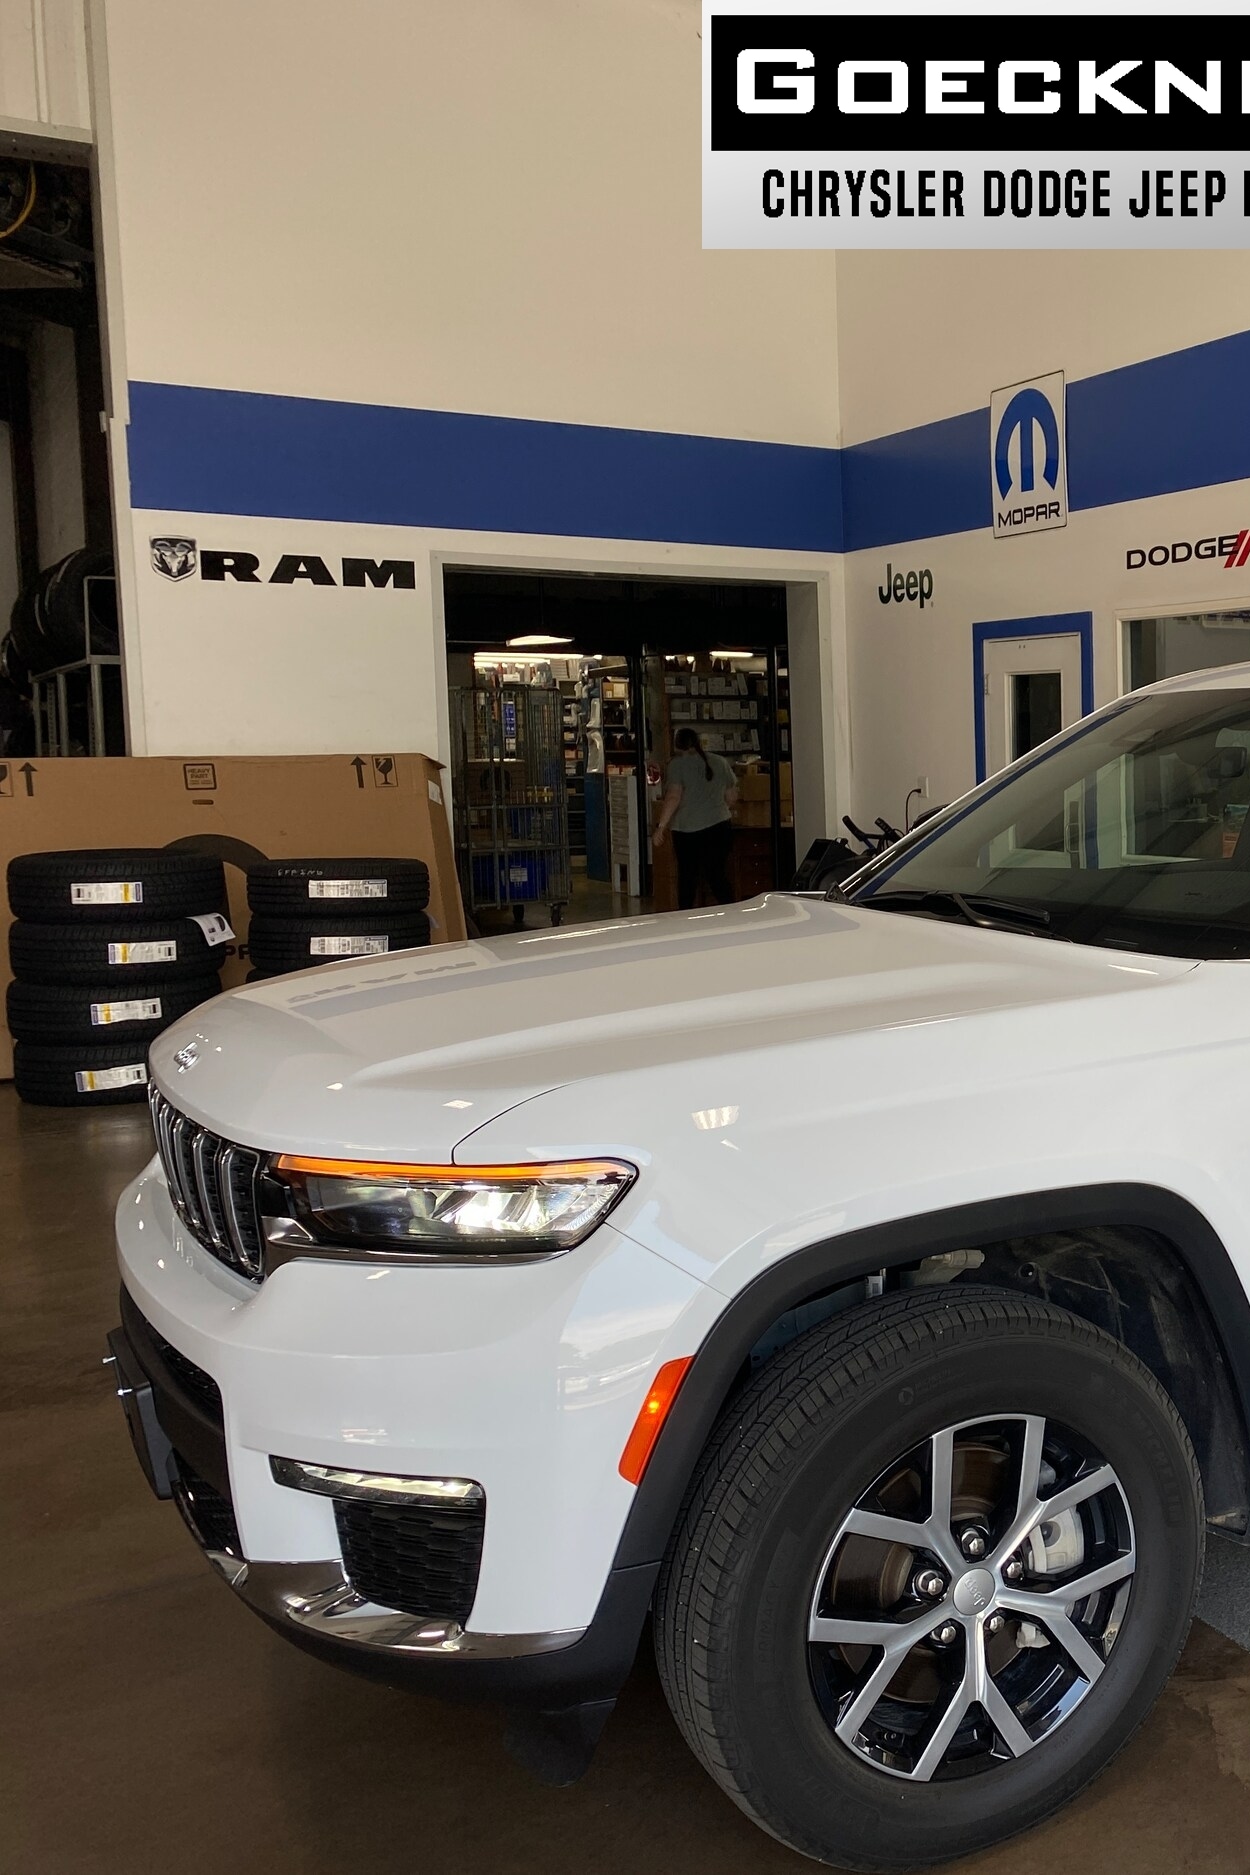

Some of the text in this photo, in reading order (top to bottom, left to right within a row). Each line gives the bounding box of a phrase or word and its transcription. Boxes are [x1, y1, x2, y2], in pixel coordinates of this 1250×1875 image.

[997, 501, 1060, 529] MOPAR
[200, 549, 416, 590] RAM
[1127, 534, 1240, 570] DODGE
[878, 563, 934, 609] Jeep
[964, 1577, 985, 1607] Jeep
